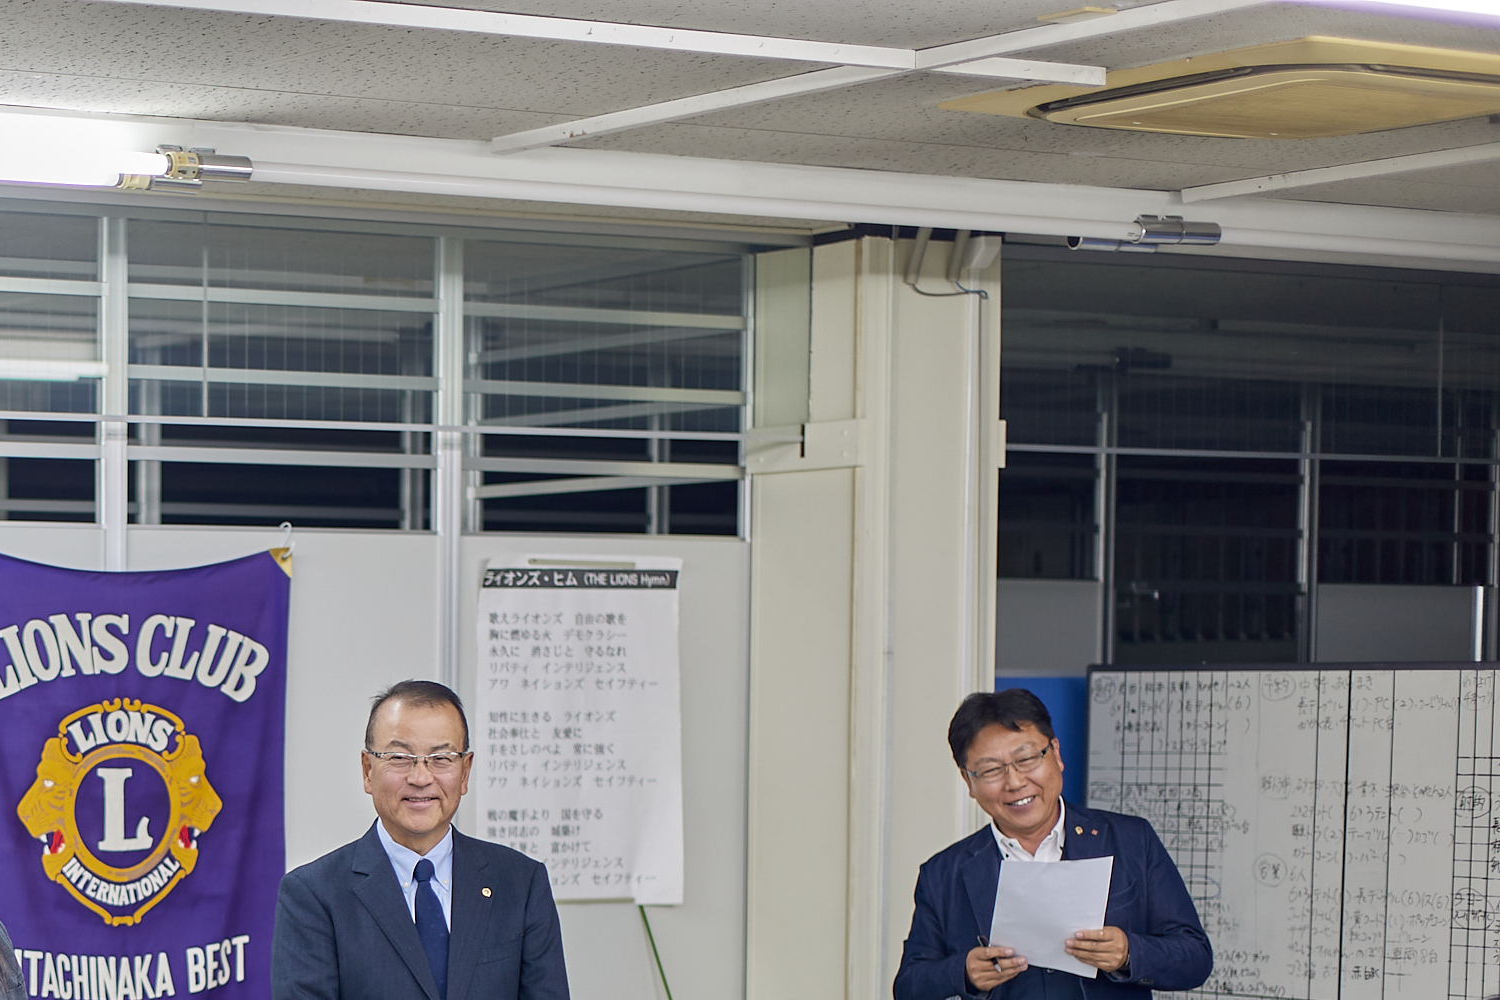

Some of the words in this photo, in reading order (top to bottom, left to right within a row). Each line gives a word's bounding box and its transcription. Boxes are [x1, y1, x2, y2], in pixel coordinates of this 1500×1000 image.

[610, 574, 638, 587] LIONS
[135, 613, 270, 703] CLUB
[67, 709, 175, 754] LIONS
[96, 767, 153, 852] L
[61, 856, 181, 906] INTERNATIONAL
[187, 935, 250, 994] BEST
